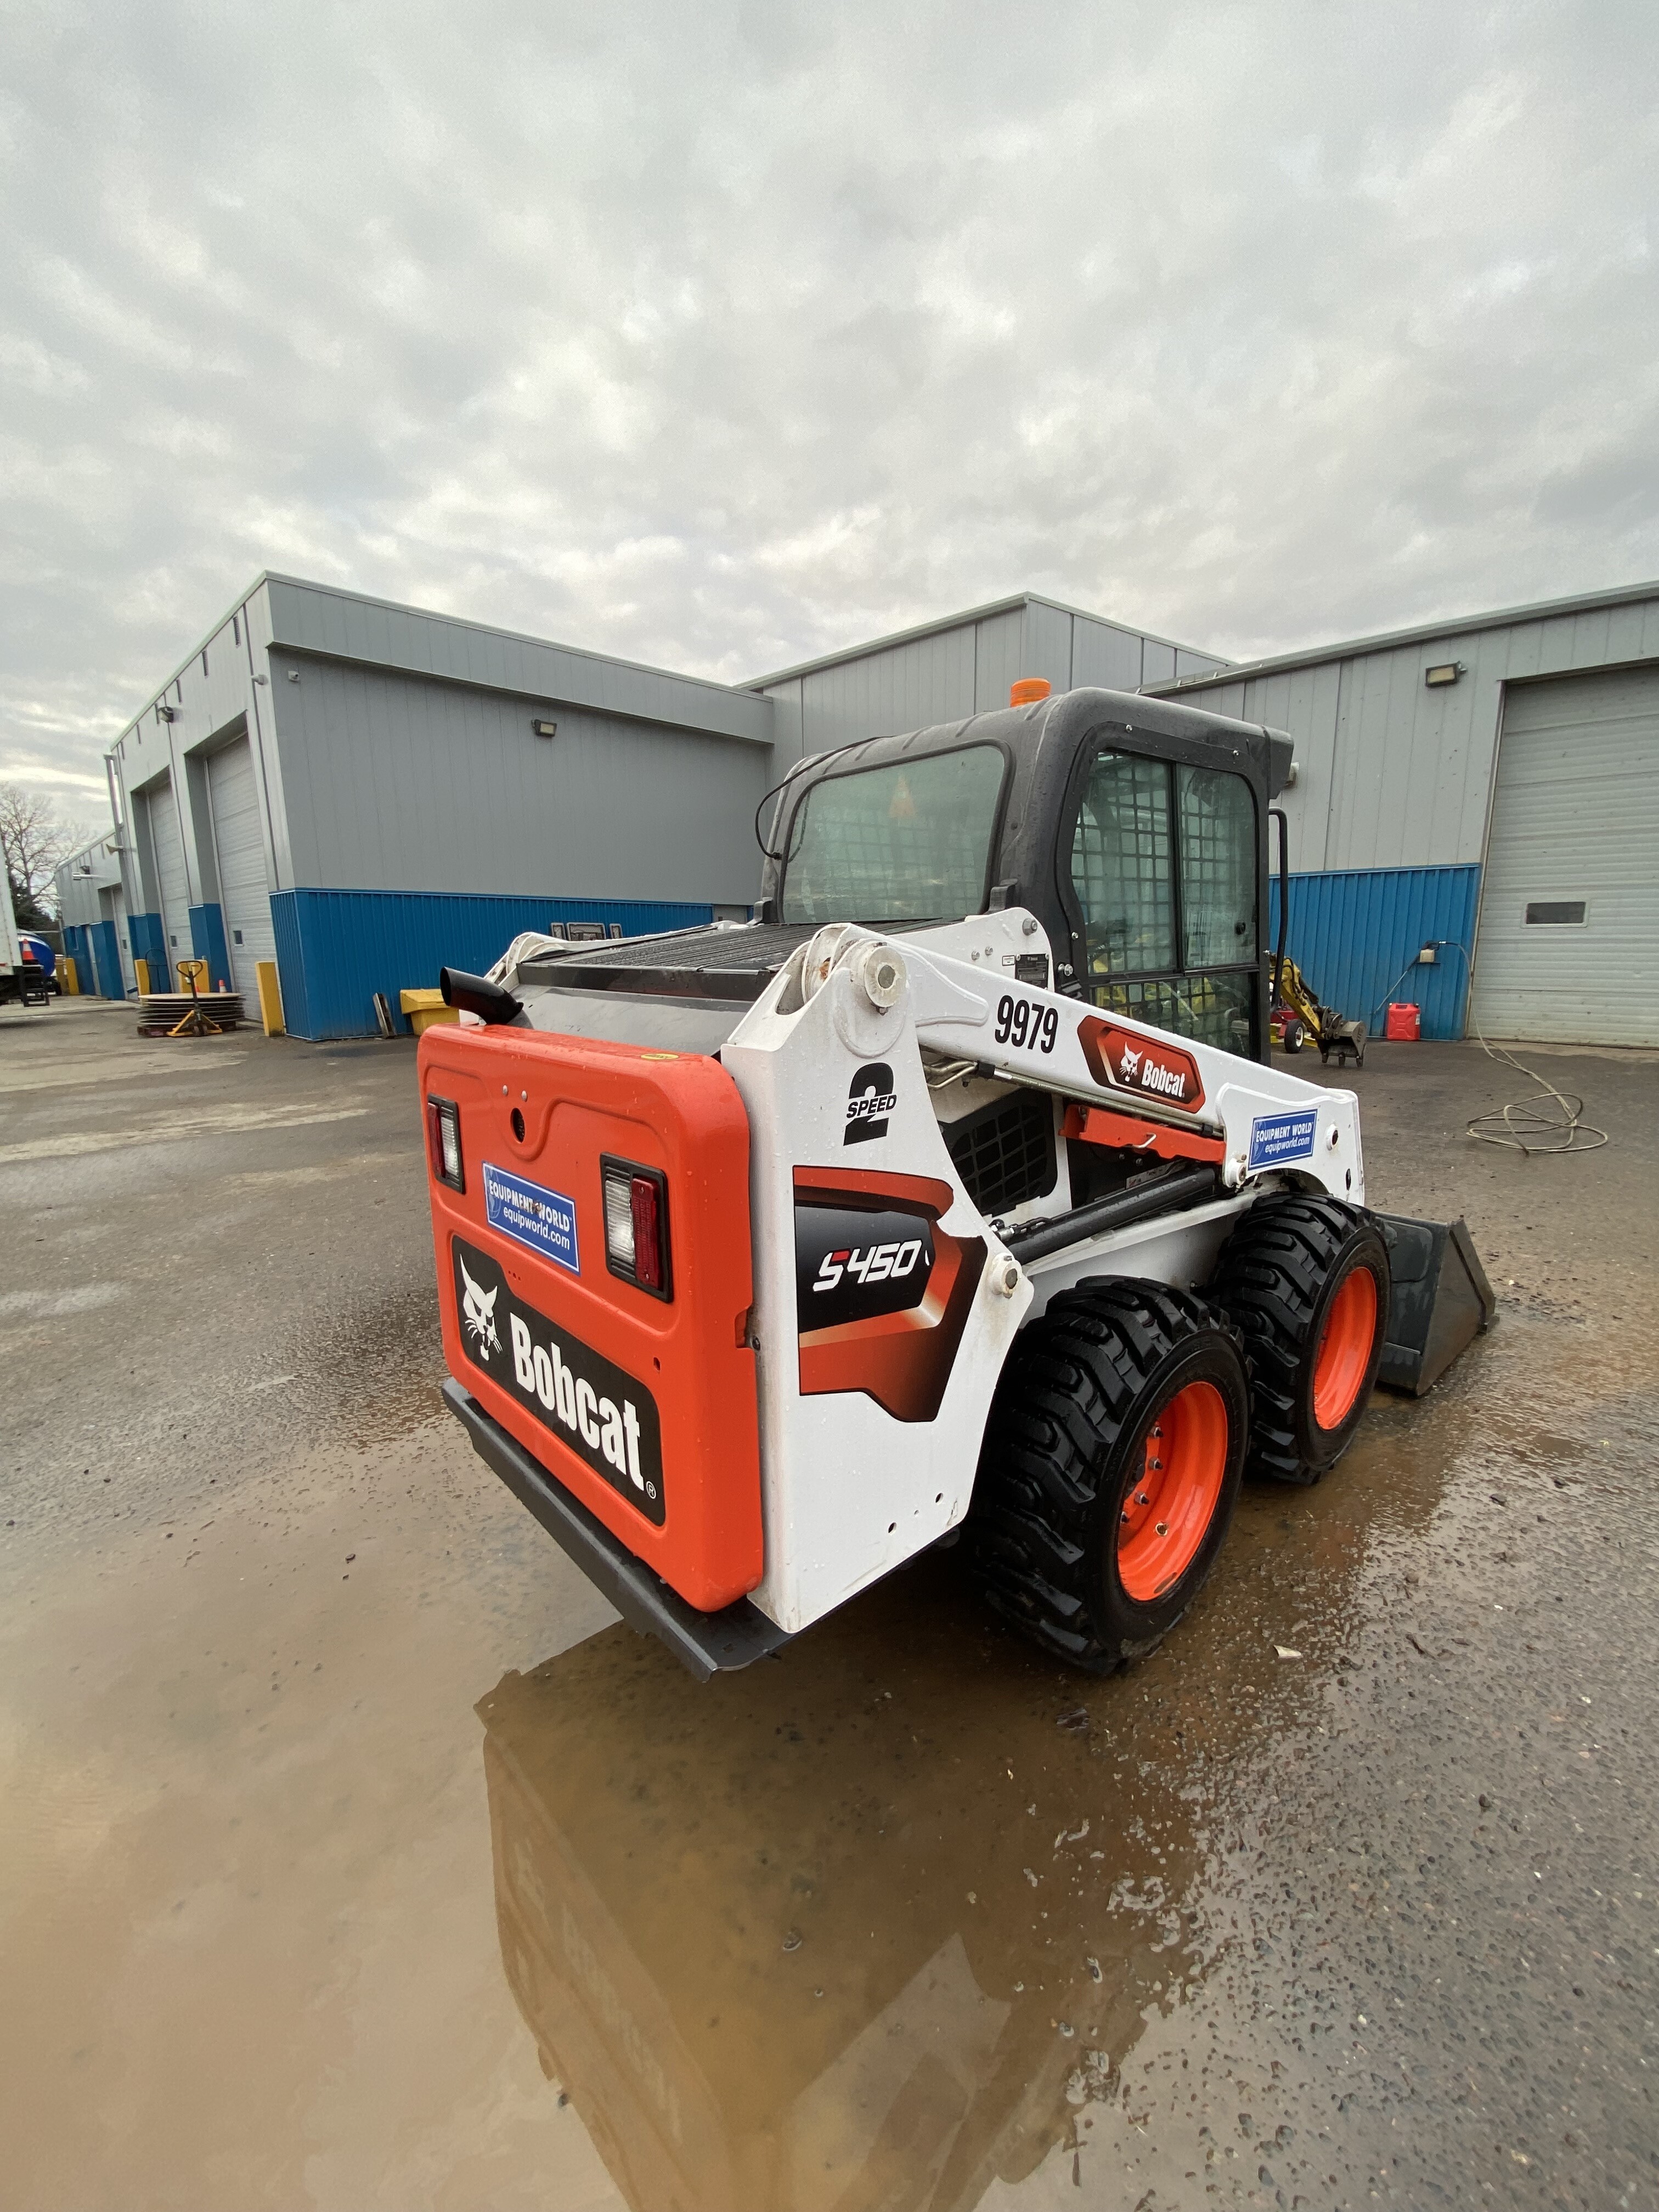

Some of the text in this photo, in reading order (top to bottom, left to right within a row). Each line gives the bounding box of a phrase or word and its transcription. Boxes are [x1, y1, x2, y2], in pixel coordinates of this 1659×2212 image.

[995, 995, 1058, 1054] 9979
[1141, 1059, 1185, 1097] Bobcat
[846, 1094, 897, 1119] SPEED
[1256, 1122, 1312, 1142] EQUIPMENT WORLD
[1265, 1137, 1310, 1154] equipworld.com
[489, 1180, 534, 1215] EQUIPMENT
[503, 1207, 570, 1250] equipworld.com
[812, 1239, 923, 1292] S450
[510, 1312, 645, 1491] Bobcat
